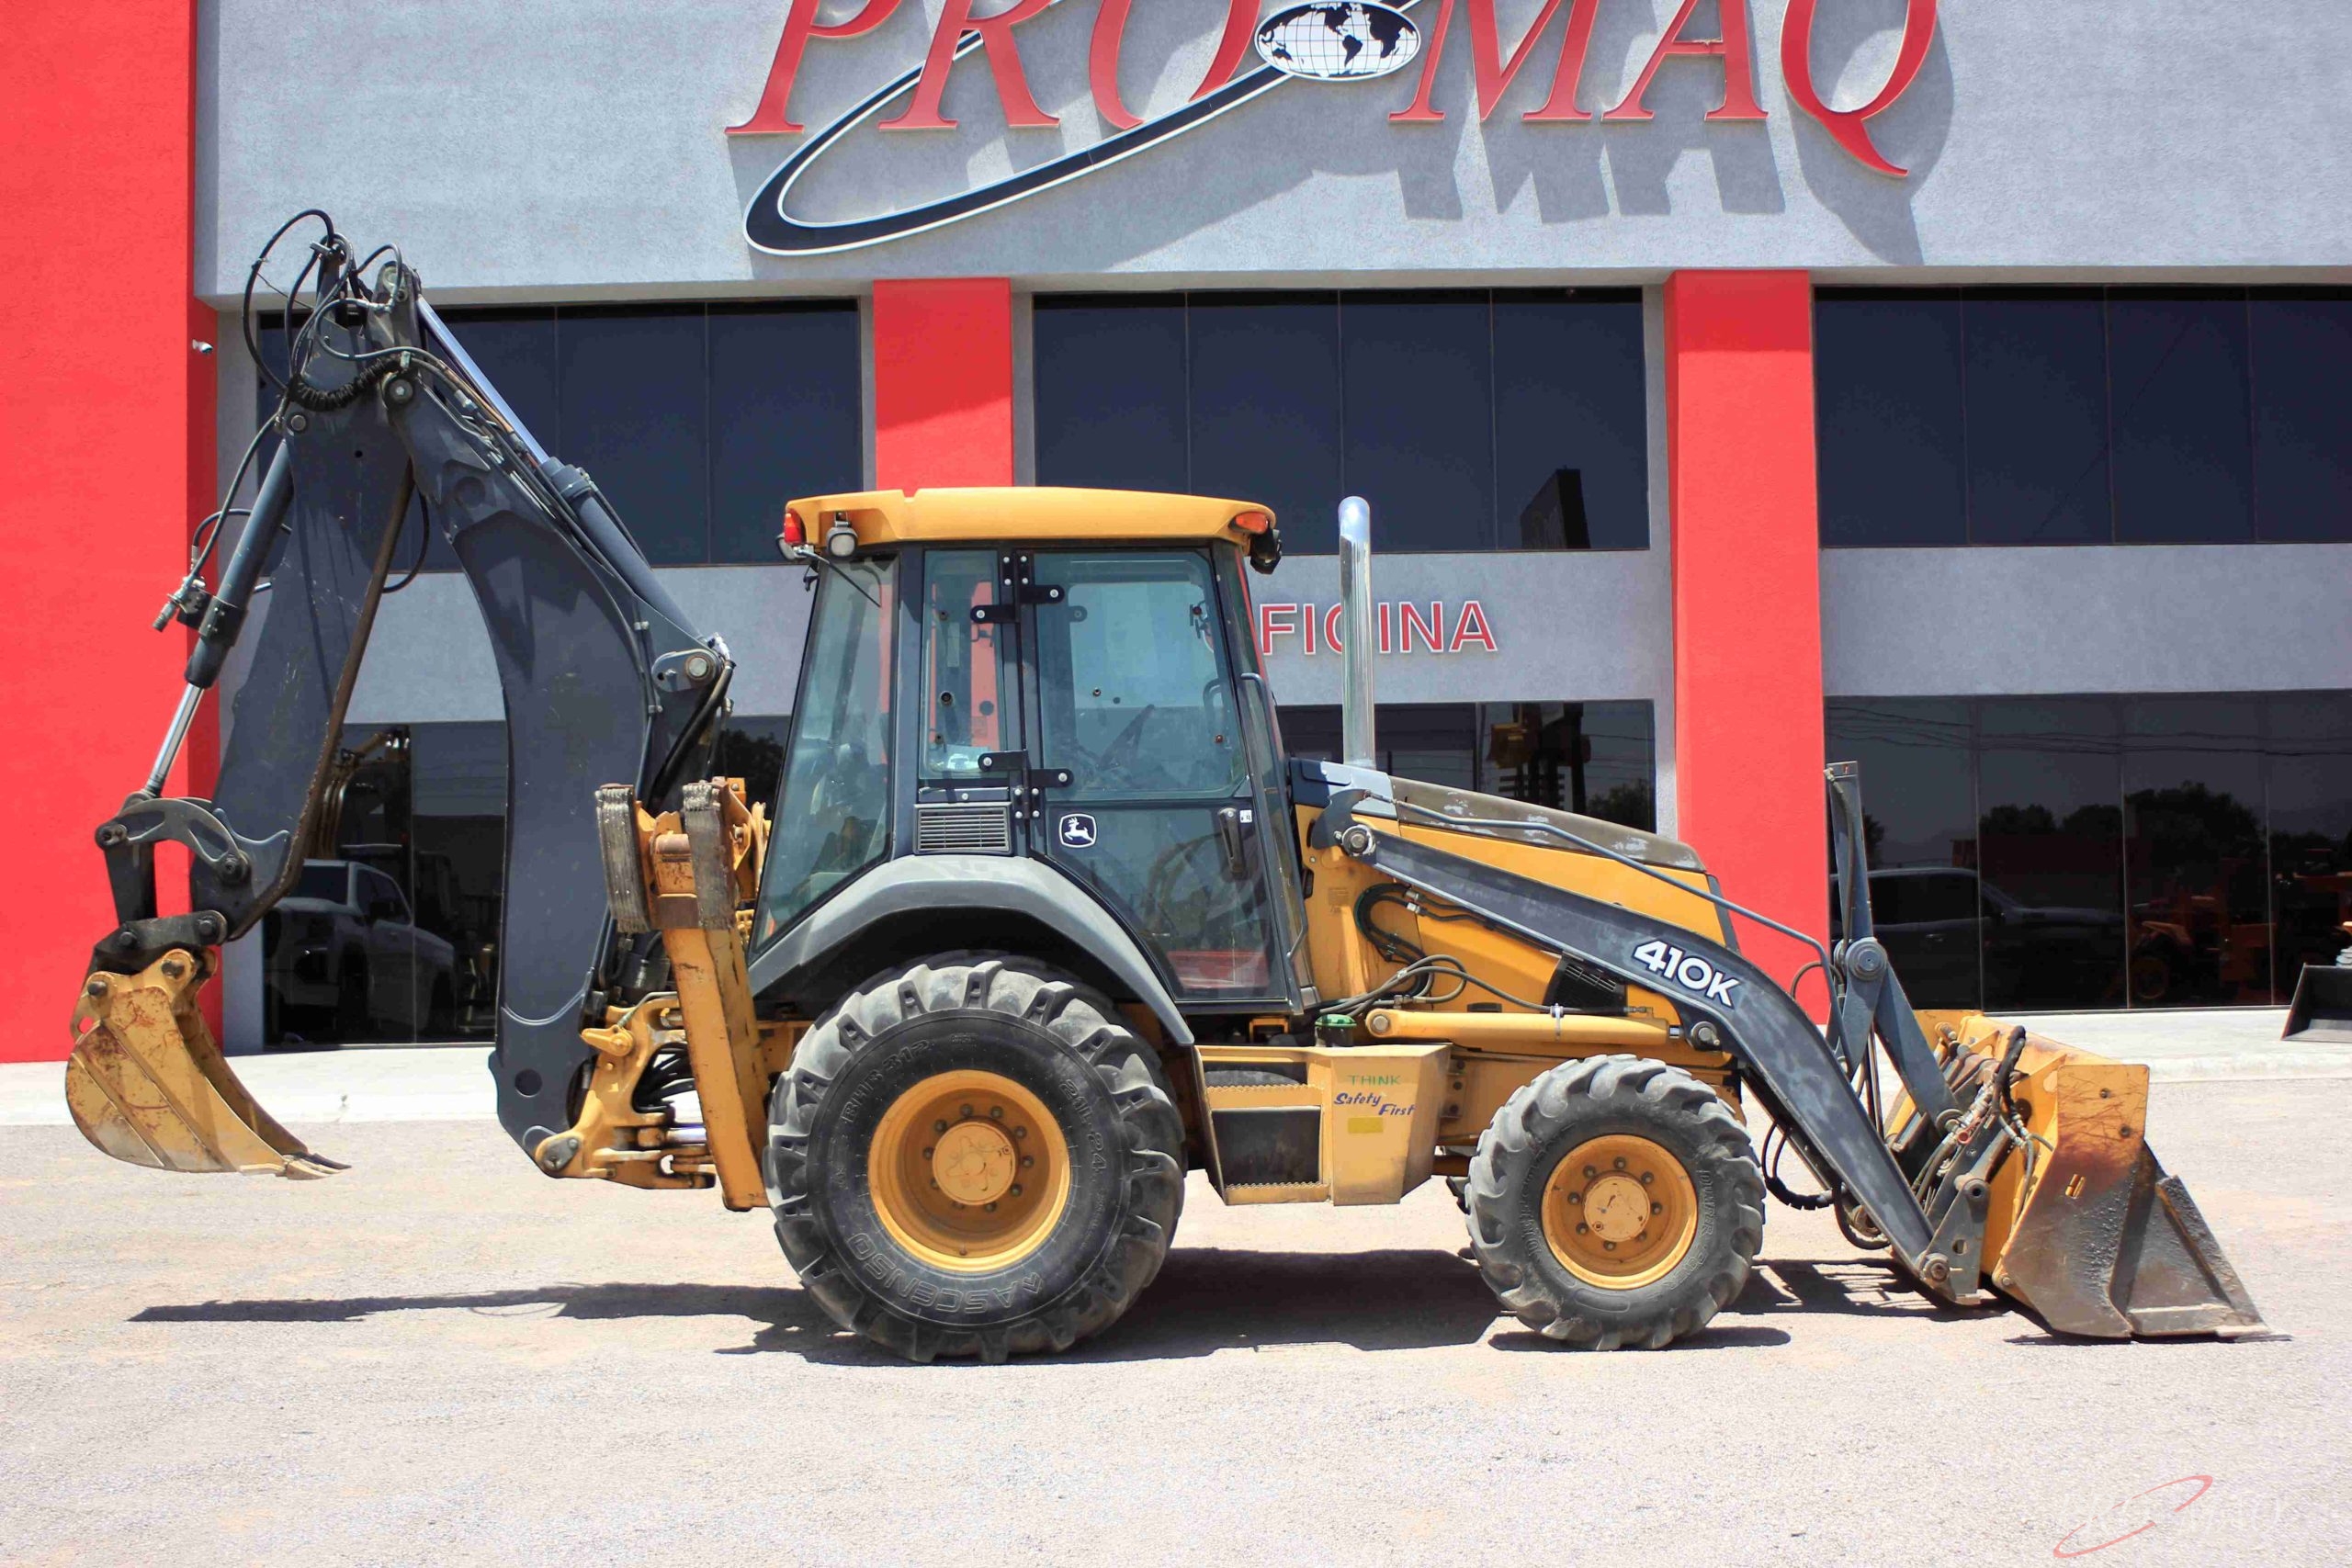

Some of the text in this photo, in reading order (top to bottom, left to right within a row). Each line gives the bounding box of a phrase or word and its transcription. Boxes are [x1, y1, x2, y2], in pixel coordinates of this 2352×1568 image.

[1632, 939, 1741, 1010] 410K
[1348, 1075, 1401, 1086] THINK
[1333, 1091, 1383, 1107] Safety
[1378, 1102, 1418, 1116] First
[846, 1232, 1019, 1314] ASCENSO
